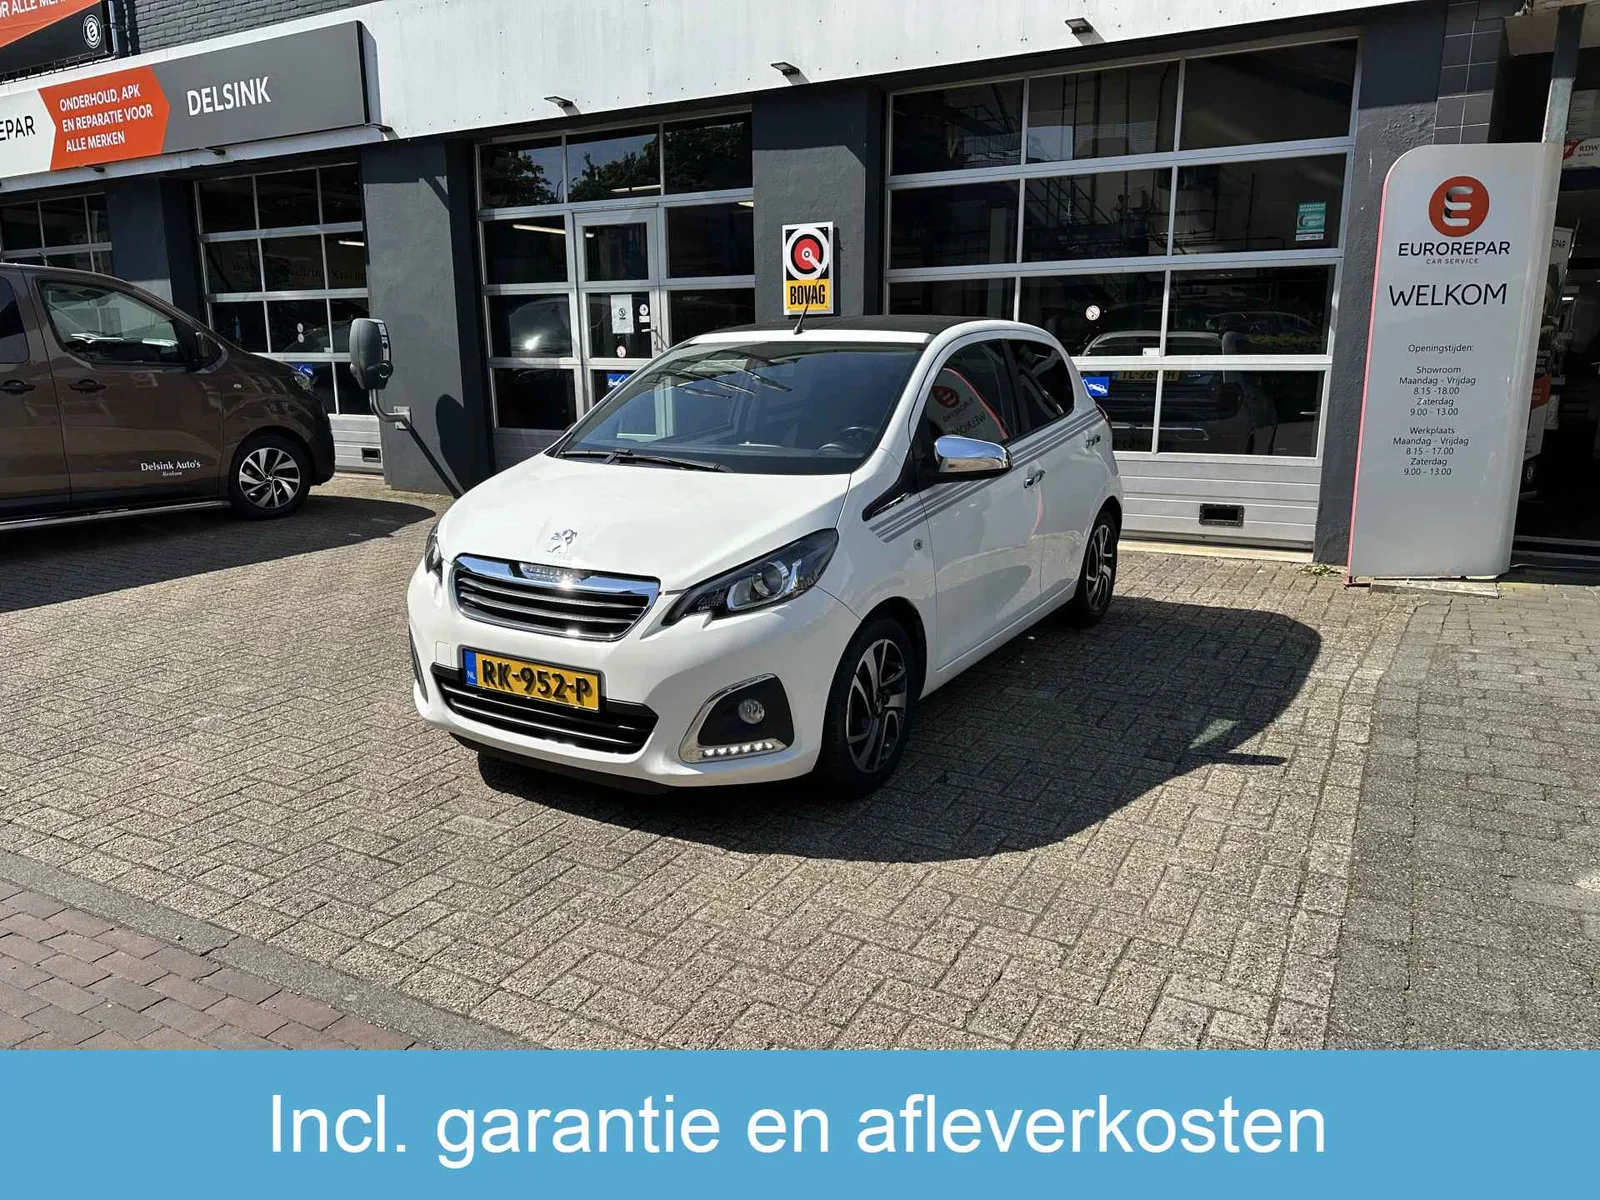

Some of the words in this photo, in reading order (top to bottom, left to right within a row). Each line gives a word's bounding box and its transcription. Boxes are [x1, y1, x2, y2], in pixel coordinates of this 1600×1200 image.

[12, 0, 38, 15] ALLE
[59, 88, 120, 112] ONDERHOUD,
[122, 84, 141, 100] APK
[187, 76, 272, 116] DELSINK
[62, 118, 75, 133] EN
[76, 110, 123, 131] REPARATIE
[125, 104, 153, 120] VOOR
[66, 137, 87, 153] ALLE
[88, 130, 126, 148] MERKEN
[1398, 241, 1511, 256] EUROREPAR
[1444, 257, 1479, 265] SERVICE
[790, 284, 826, 305] BOVAG
[1389, 283, 1508, 306] WELKOM
[1407, 343, 1474, 354] Openingstijden:
[1416, 366, 1462, 374] Showroom
[1399, 376, 1438, 387] Maandag
[1447, 376, 1477, 386] Vrijdag
[1413, 387, 1431, 395] 8.15
[1416, 397, 1454, 407] Zaterdag
[1410, 408, 1428, 416] 9.00
[1436, 407, 1459, 416] 13.00
[1409, 426, 1455, 436] Werkplaats
[1393, 437, 1432, 447] Maandag
[1440, 437, 1470, 446] Vrijdag
[1405, 447, 1423, 455] 8.15
[1432, 447, 1454, 455] 17.00
[140, 460, 174, 471] Delsink
[176, 459, 201, 469] Auto's
[1410, 457, 1448, 467] Zaterdag
[1403, 468, 1421, 476] 9.00
[1430, 467, 1452, 476] 13.00
[466, 670, 476, 680] NL
[481, 659, 592, 704] RK-952-P
